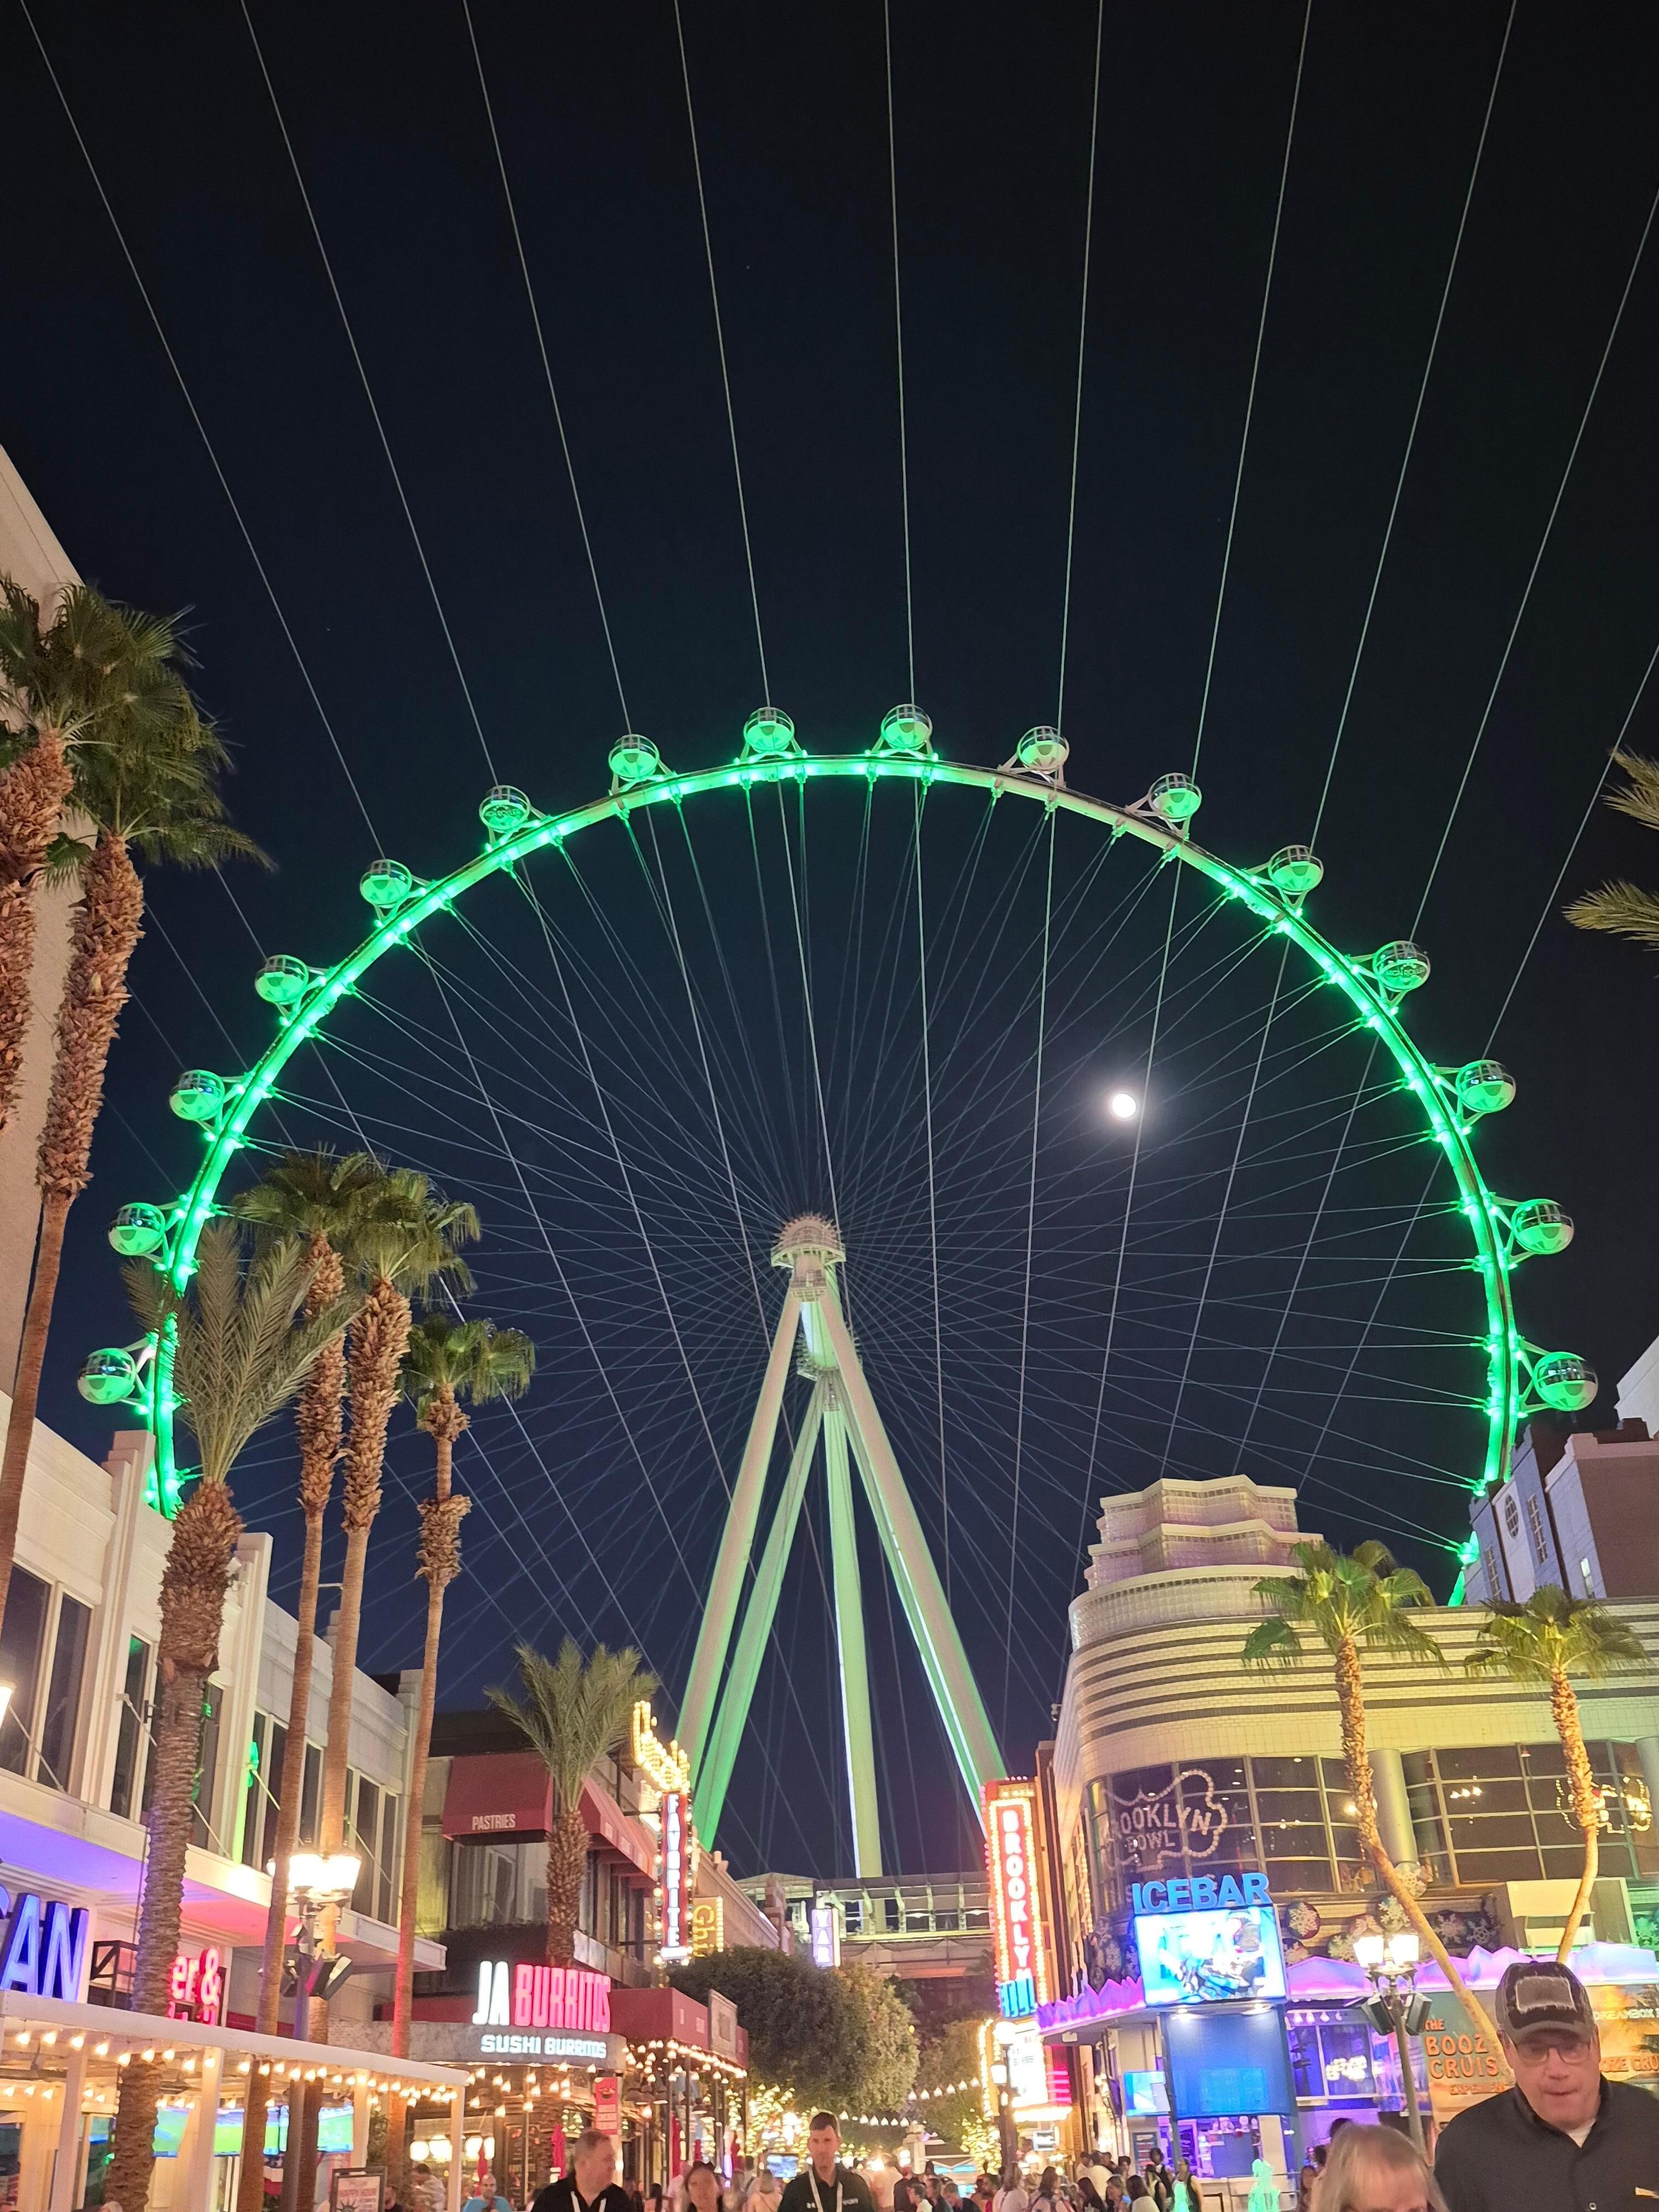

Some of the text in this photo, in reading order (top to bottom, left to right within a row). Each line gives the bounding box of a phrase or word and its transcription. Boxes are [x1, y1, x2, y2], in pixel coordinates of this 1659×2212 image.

[472, 1813, 516, 1830] PASTRIES
[1125, 1829, 1176, 1853] BOWL
[666, 1793, 681, 1947] FAVORITE
[1131, 1872, 1274, 1914] ICEBAR
[170, 1946, 221, 2007] er &
[472, 1960, 611, 2033] JA BURRITOS
[481, 2034, 607, 2058] SUSHI BURRITOS
[1425, 2034, 1488, 2056] BOOZ
[1429, 2056, 1499, 2079] CRUIS
[1600, 2057, 1629, 2073] OZE
